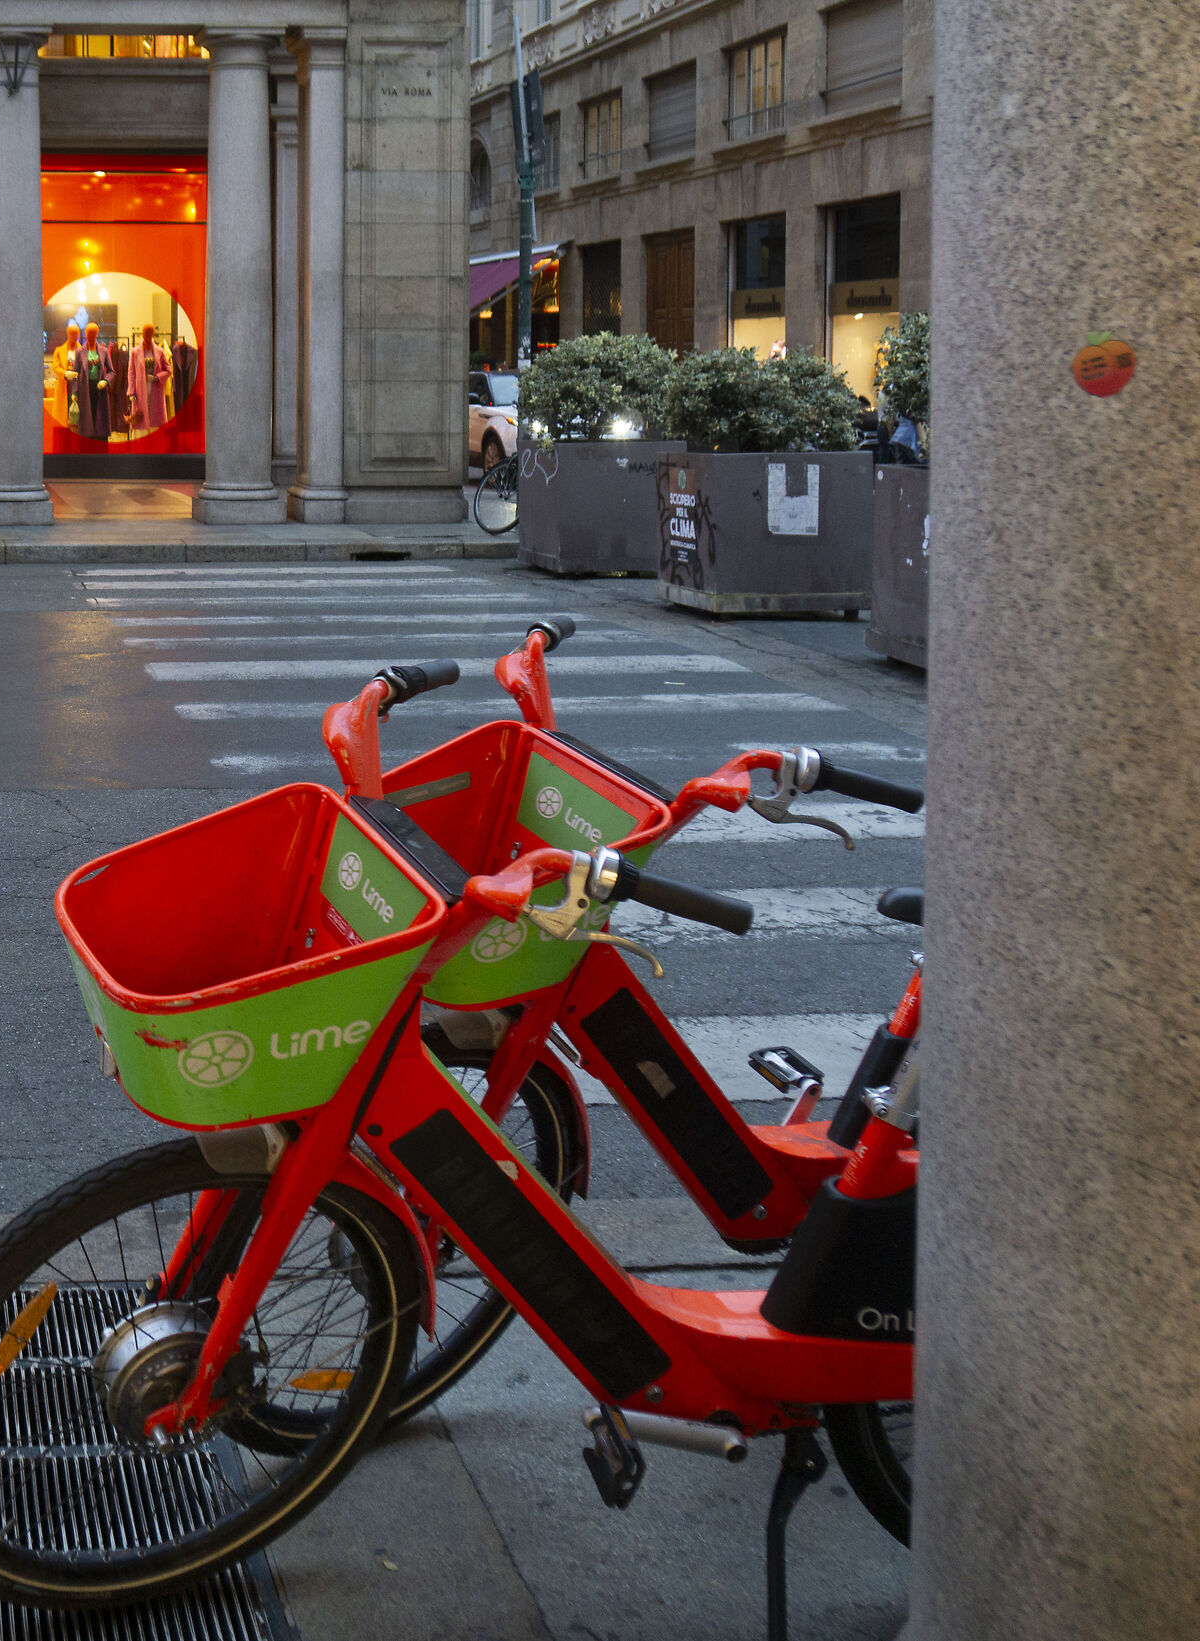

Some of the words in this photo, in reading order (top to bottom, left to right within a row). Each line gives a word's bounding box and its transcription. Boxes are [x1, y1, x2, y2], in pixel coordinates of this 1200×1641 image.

[381, 87, 398, 97] VIA
[404, 87, 432, 97] ROMA
[669, 492, 696, 507] SCIOPERO
[670, 518, 696, 539] CLIMA
[565, 807, 602, 843] Lime
[362, 878, 394, 924] Lime
[271, 1020, 371, 1059] Lime
[859, 1307, 900, 1331] On
